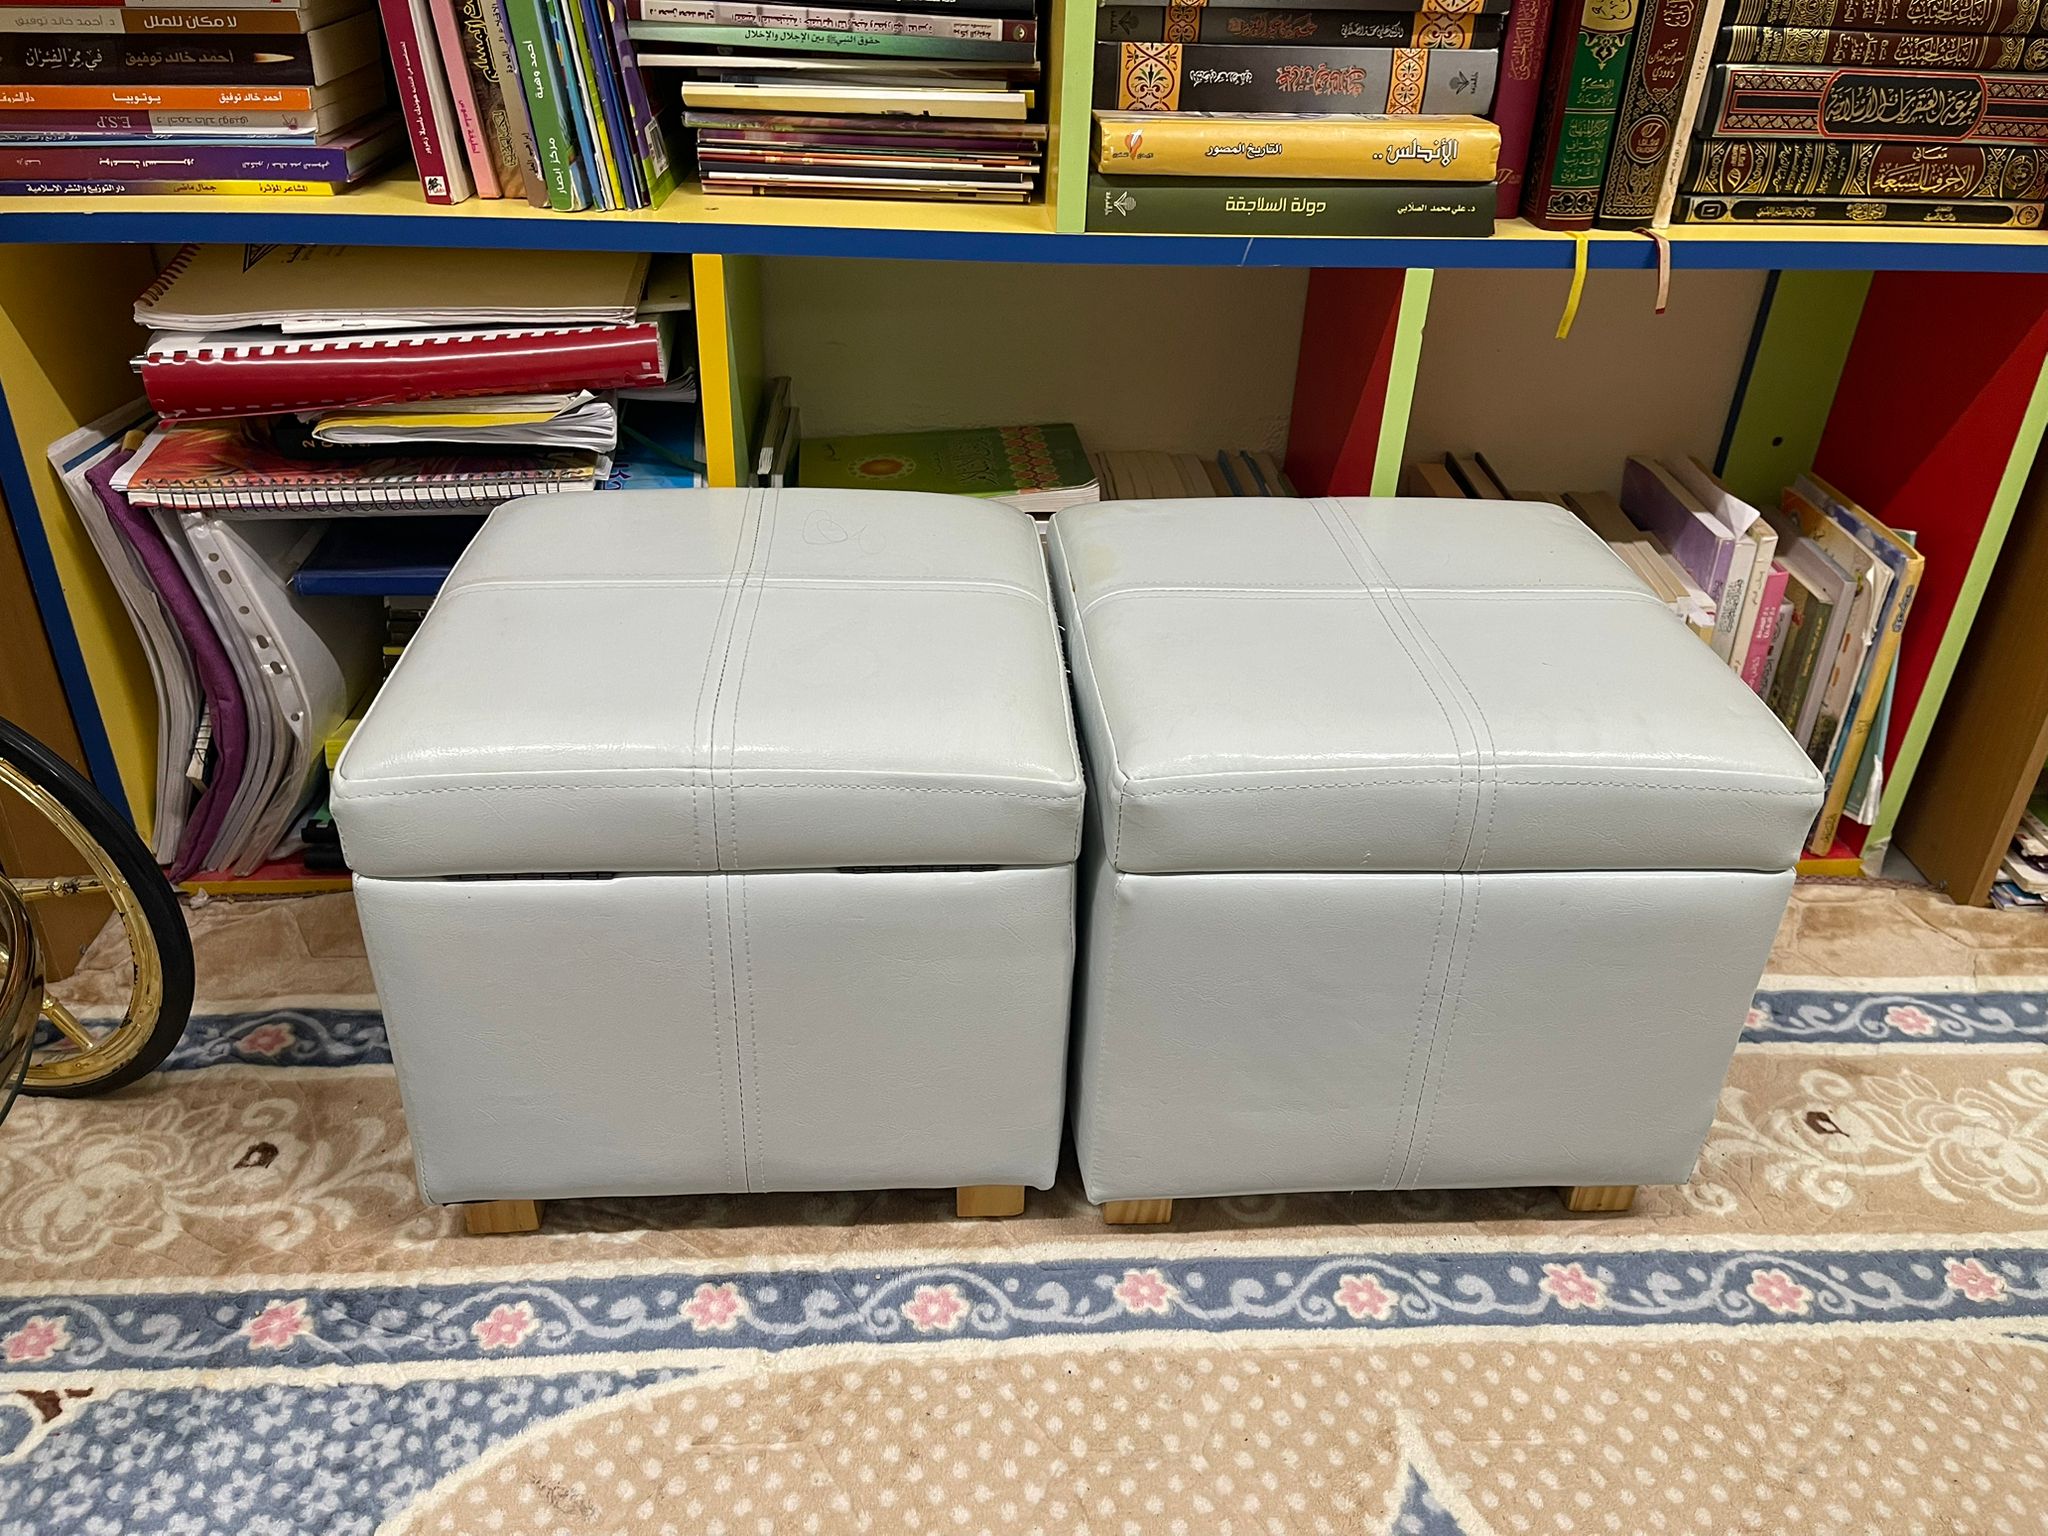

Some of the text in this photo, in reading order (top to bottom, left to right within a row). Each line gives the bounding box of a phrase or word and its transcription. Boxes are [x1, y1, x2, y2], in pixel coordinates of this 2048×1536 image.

[658, 8, 678, 17] محسن
[679, 10, 697, 18] محمد
[697, 9, 715, 19] صالح
[15, 16, 48, 27] توفيق
[51, 16, 74, 26] خالد
[144, 15, 237, 29] لا مكان للملل
[758, 14, 798, 27] الفلسطينية
[811, 33, 825, 43] بين
[857, 35, 881, 46] حقوق
[85, 48, 103, 71] في
[125, 51, 162, 66] توفيق
[165, 50, 196, 63] خالد
[522, 40, 545, 99] أحمد وهبة
[112, 93, 162, 104] يوتوبيا
[218, 91, 282, 103] أحمد خالد توفيق
[1877, 87, 1945, 124] العبقريات
[97, 115, 132, 129] E.S.P
[195, 116, 216, 126] خالد
[218, 115, 249, 125] توفيق
[467, 128, 480, 155] لطيفة
[548, 137, 561, 165] مركز
[1204, 143, 1283, 160] التاريخ المصور
[1385, 137, 1459, 167] الأندلس
[1911, 146, 1949, 162] معاني
[272, 161, 289, 169] خالد
[64, 184, 87, 194] والنشر
[87, 184, 115, 194] التوزيع
[196, 184, 217, 194] جمال
[259, 183, 308, 194] المشاعر المؤثرة
[1225, 196, 1327, 217] دولة السلاجقة
[1430, 203, 1451, 213] محمد
[1451, 203, 1466, 215] علي
